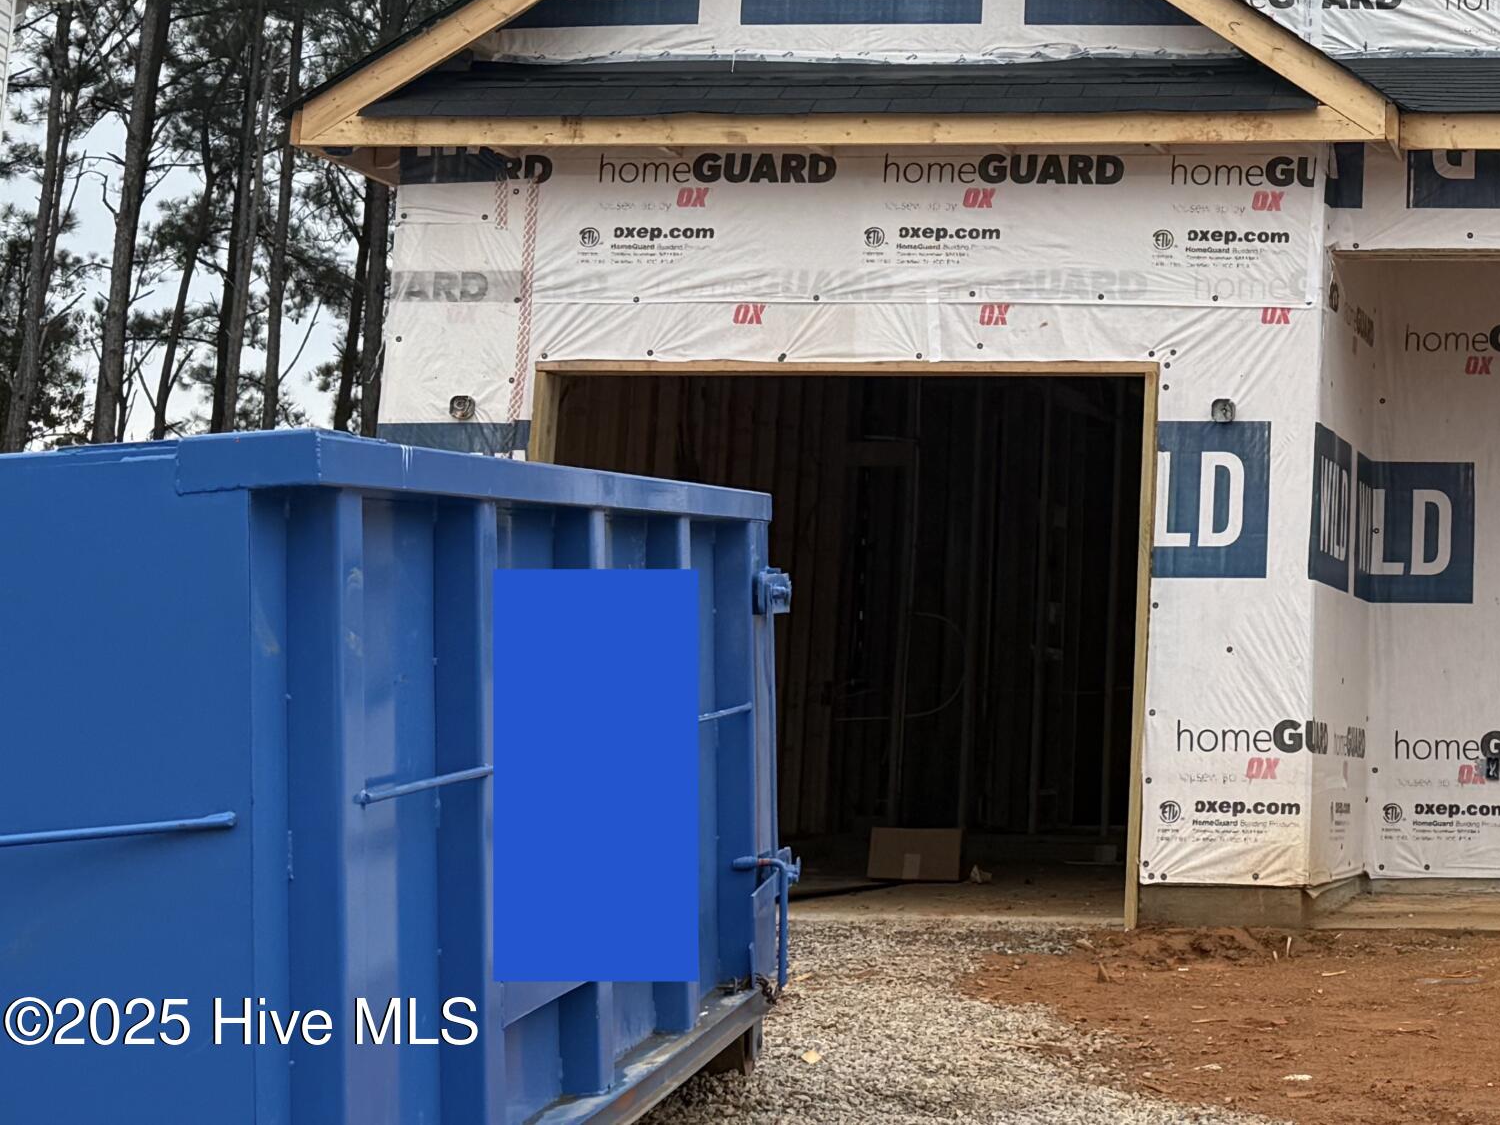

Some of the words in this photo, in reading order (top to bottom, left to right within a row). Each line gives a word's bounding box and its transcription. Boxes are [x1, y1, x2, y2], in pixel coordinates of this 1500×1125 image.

[599, 153, 837, 184] homeGUARD
[883, 153, 1125, 186] homeGUARD
[676, 187, 710, 208] OX
[963, 187, 997, 209] OX
[1252, 190, 1285, 212] OX
[613, 226, 715, 241] oxep.com
[898, 226, 1001, 242] oxep.com
[1187, 229, 1290, 245] oxep.com
[733, 304, 766, 325] OX
[979, 304, 1011, 326] OX
[1465, 356, 1494, 375] OX
[1246, 757, 1280, 780] OX
[1194, 800, 1301, 817] oxep.com
